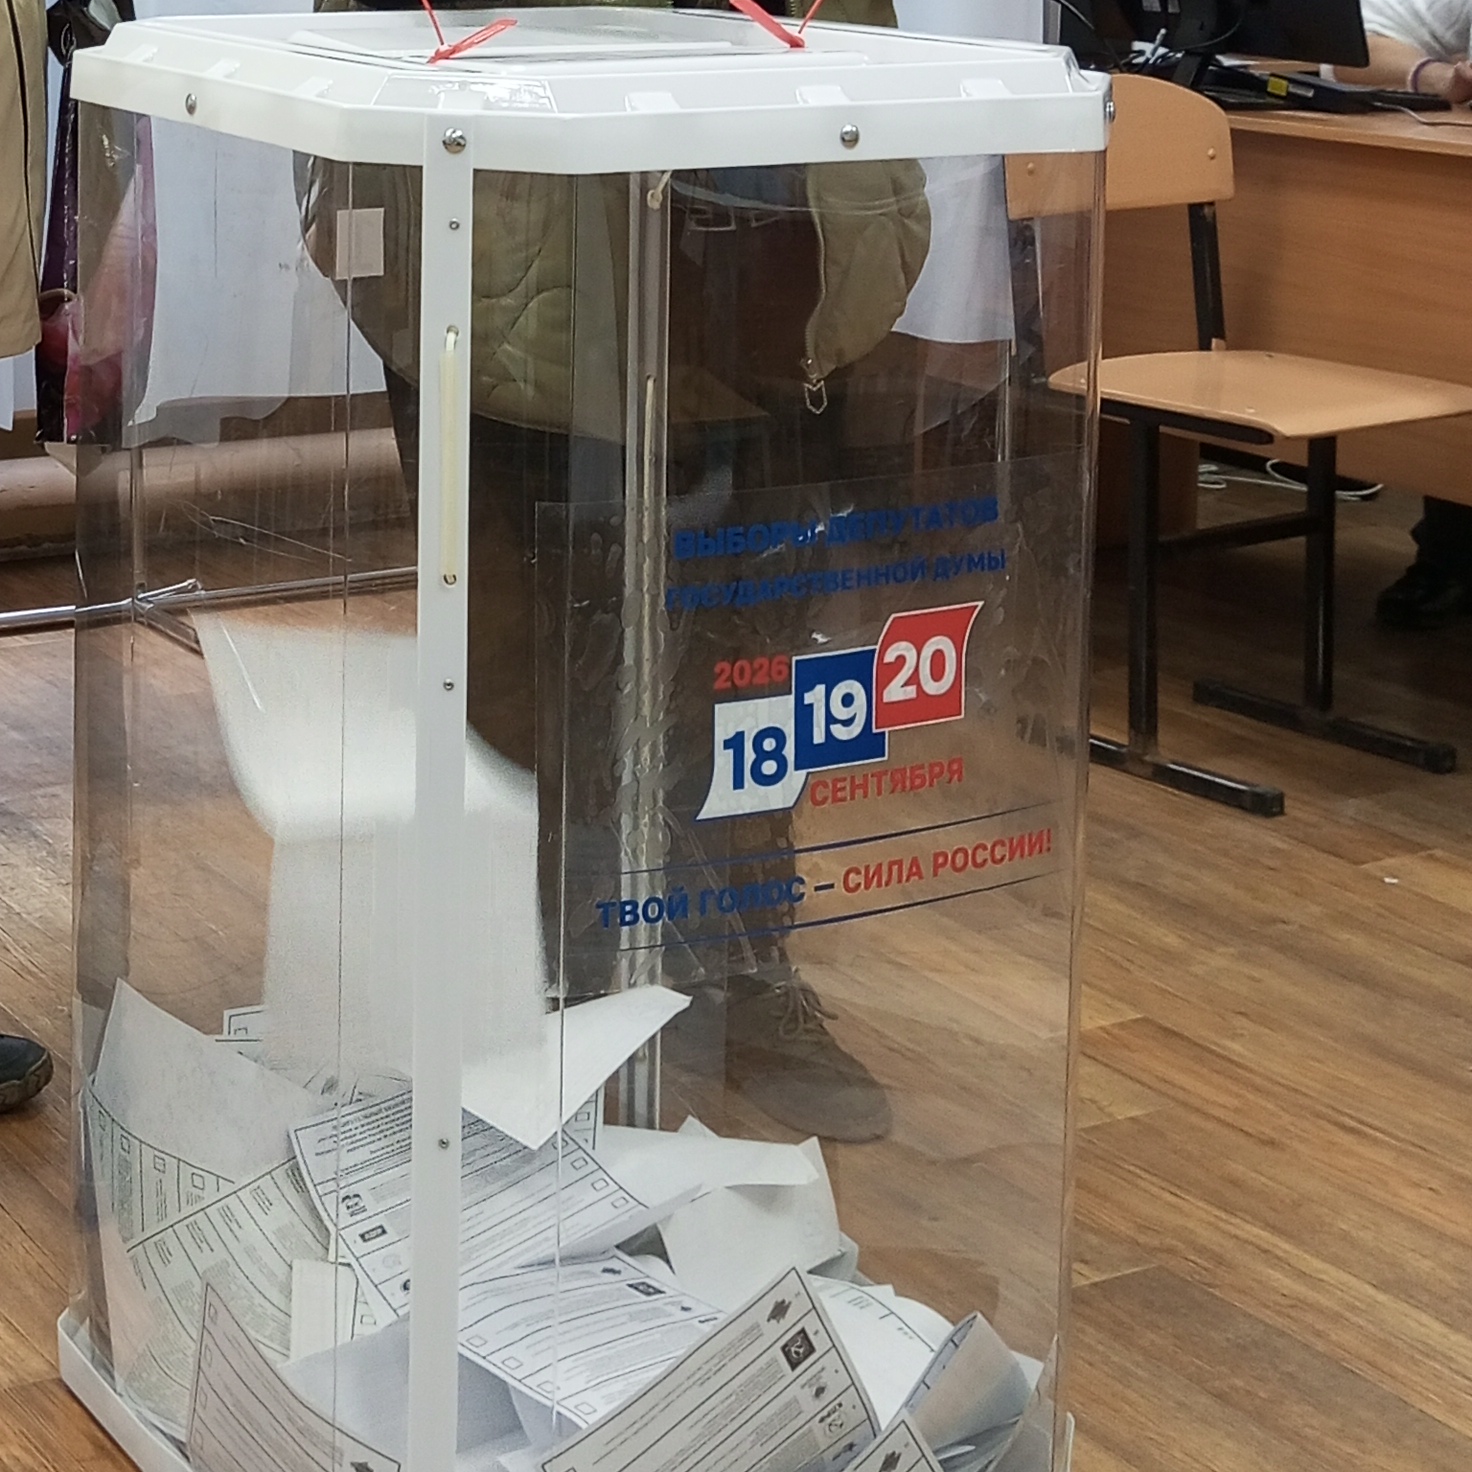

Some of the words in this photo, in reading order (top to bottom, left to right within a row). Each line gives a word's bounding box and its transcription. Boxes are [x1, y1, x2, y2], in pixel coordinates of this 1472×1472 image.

[673, 518, 818, 561] ВЫБОРЫ
[825, 496, 999, 547] ДЕПУТАТОВ
[666, 555, 926, 612] ГОСУДАРСТВЕННОЙ
[933, 549, 1007, 583] ДУМЫ
[713, 654, 790, 691] 2026
[883, 636, 956, 703] 20
[804, 679, 868, 746] 19
[723, 726, 788, 791] 18
[810, 757, 964, 807] СЕНТЯБРЯ
[595, 887, 689, 929] ТВОЙ
[699, 876, 805, 918] ГОЛОС
[842, 855, 924, 895] СИЛА
[932, 828, 1052, 878] РОССИИ!
